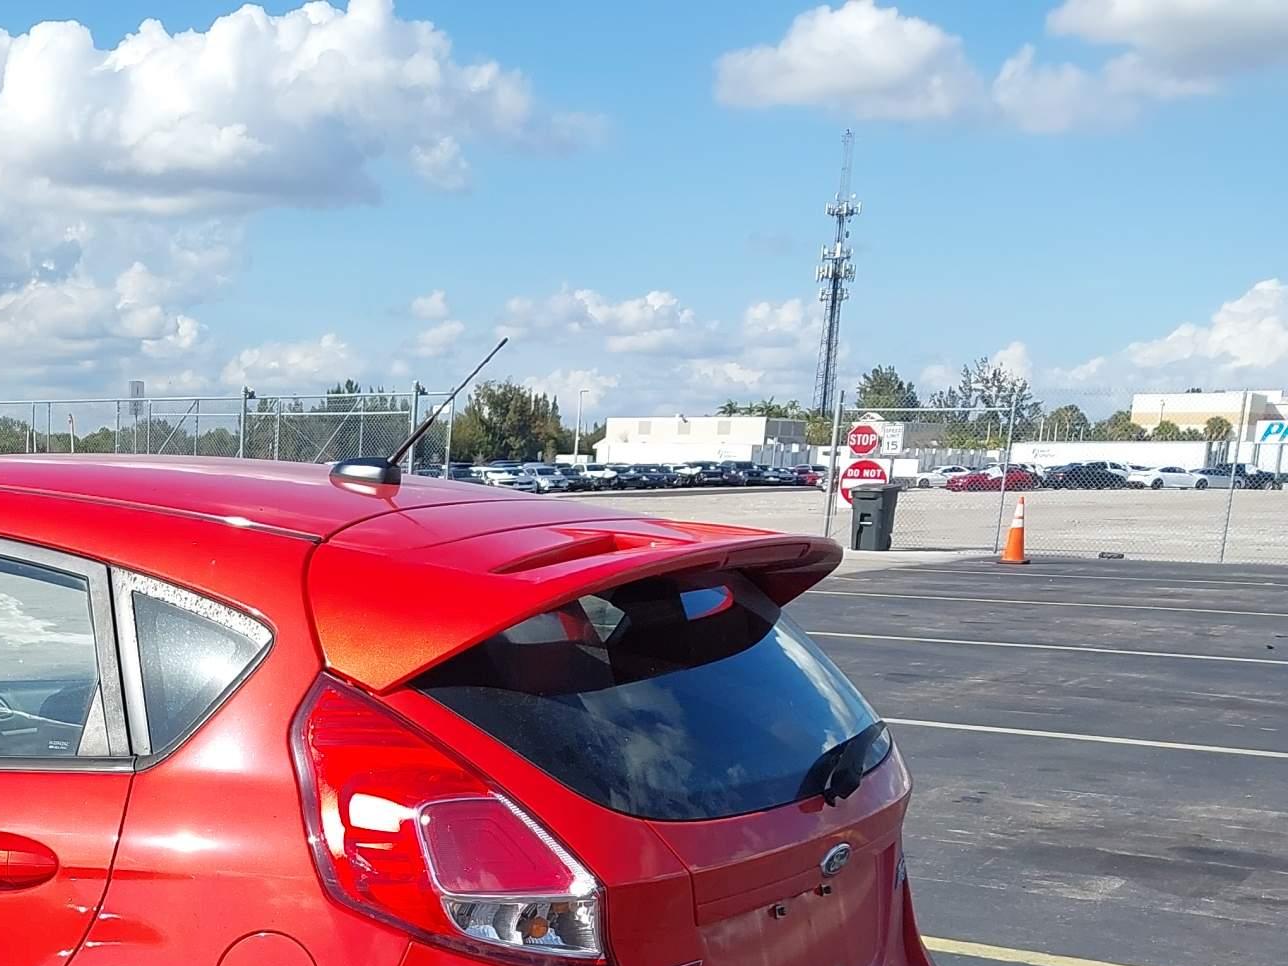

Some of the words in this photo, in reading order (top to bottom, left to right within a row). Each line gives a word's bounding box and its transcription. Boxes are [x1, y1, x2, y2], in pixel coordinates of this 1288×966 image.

[850, 434, 877, 446] STOP
[886, 441, 898, 451] 15
[847, 469, 860, 477] DO
[863, 469, 882, 477] NOT
